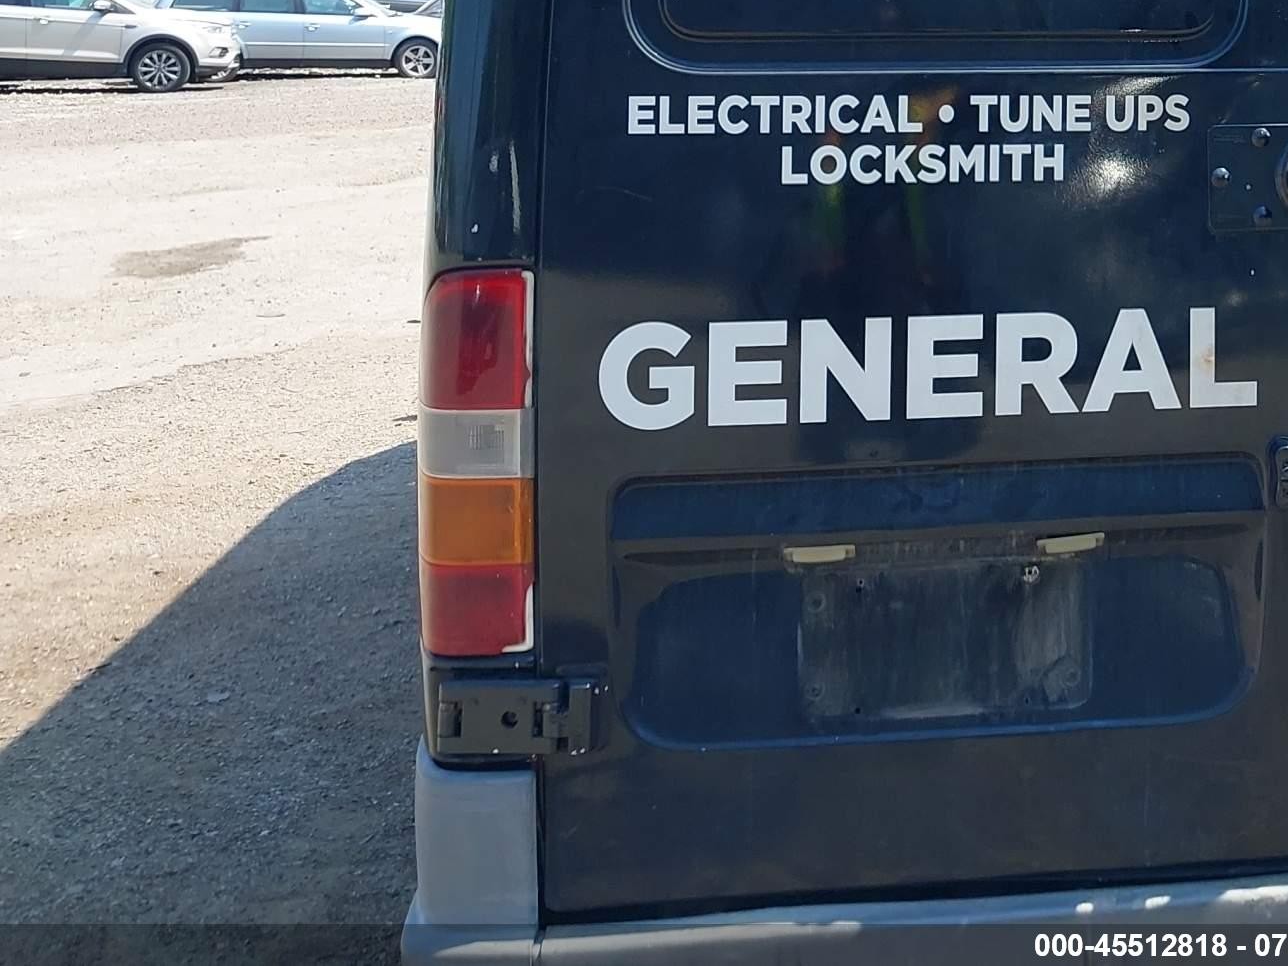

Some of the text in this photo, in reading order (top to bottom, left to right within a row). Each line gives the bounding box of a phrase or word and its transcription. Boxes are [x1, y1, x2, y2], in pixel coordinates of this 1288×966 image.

[626, 94, 924, 135] ELECTRICAL
[970, 94, 1092, 133] TUNE
[1105, 94, 1190, 131] UPS
[780, 143, 1065, 185] LOCKSMITH
[598, 307, 1258, 431] GENERAL
